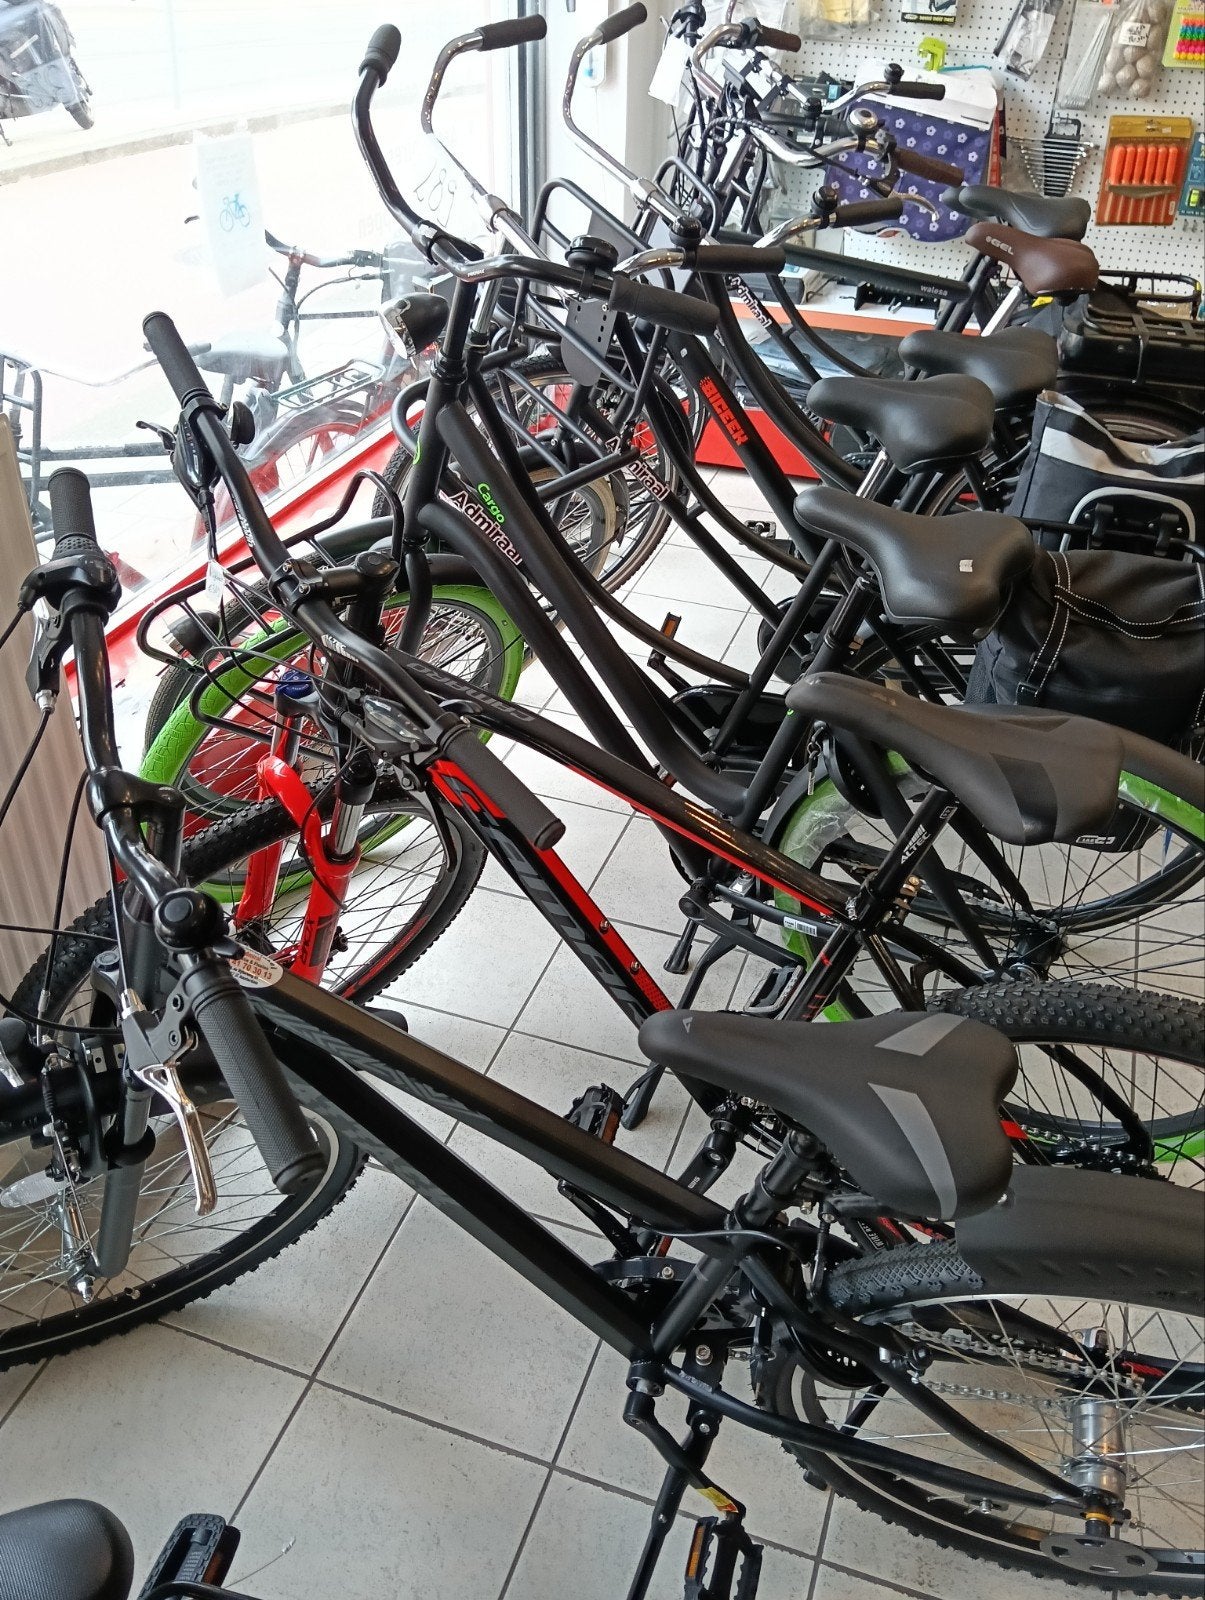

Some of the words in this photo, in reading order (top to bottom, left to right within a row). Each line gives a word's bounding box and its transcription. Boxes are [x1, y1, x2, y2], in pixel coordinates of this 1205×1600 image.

[477, 483, 505, 523] Cargo
[447, 490, 523, 566] Admiraal
[900, 833, 932, 865] ALTEC
[441, 774, 650, 1029] CAMAR
[242, 962, 252, 972] 70
[252, 966, 262, 976] 30
[263, 971, 273, 980] 13
